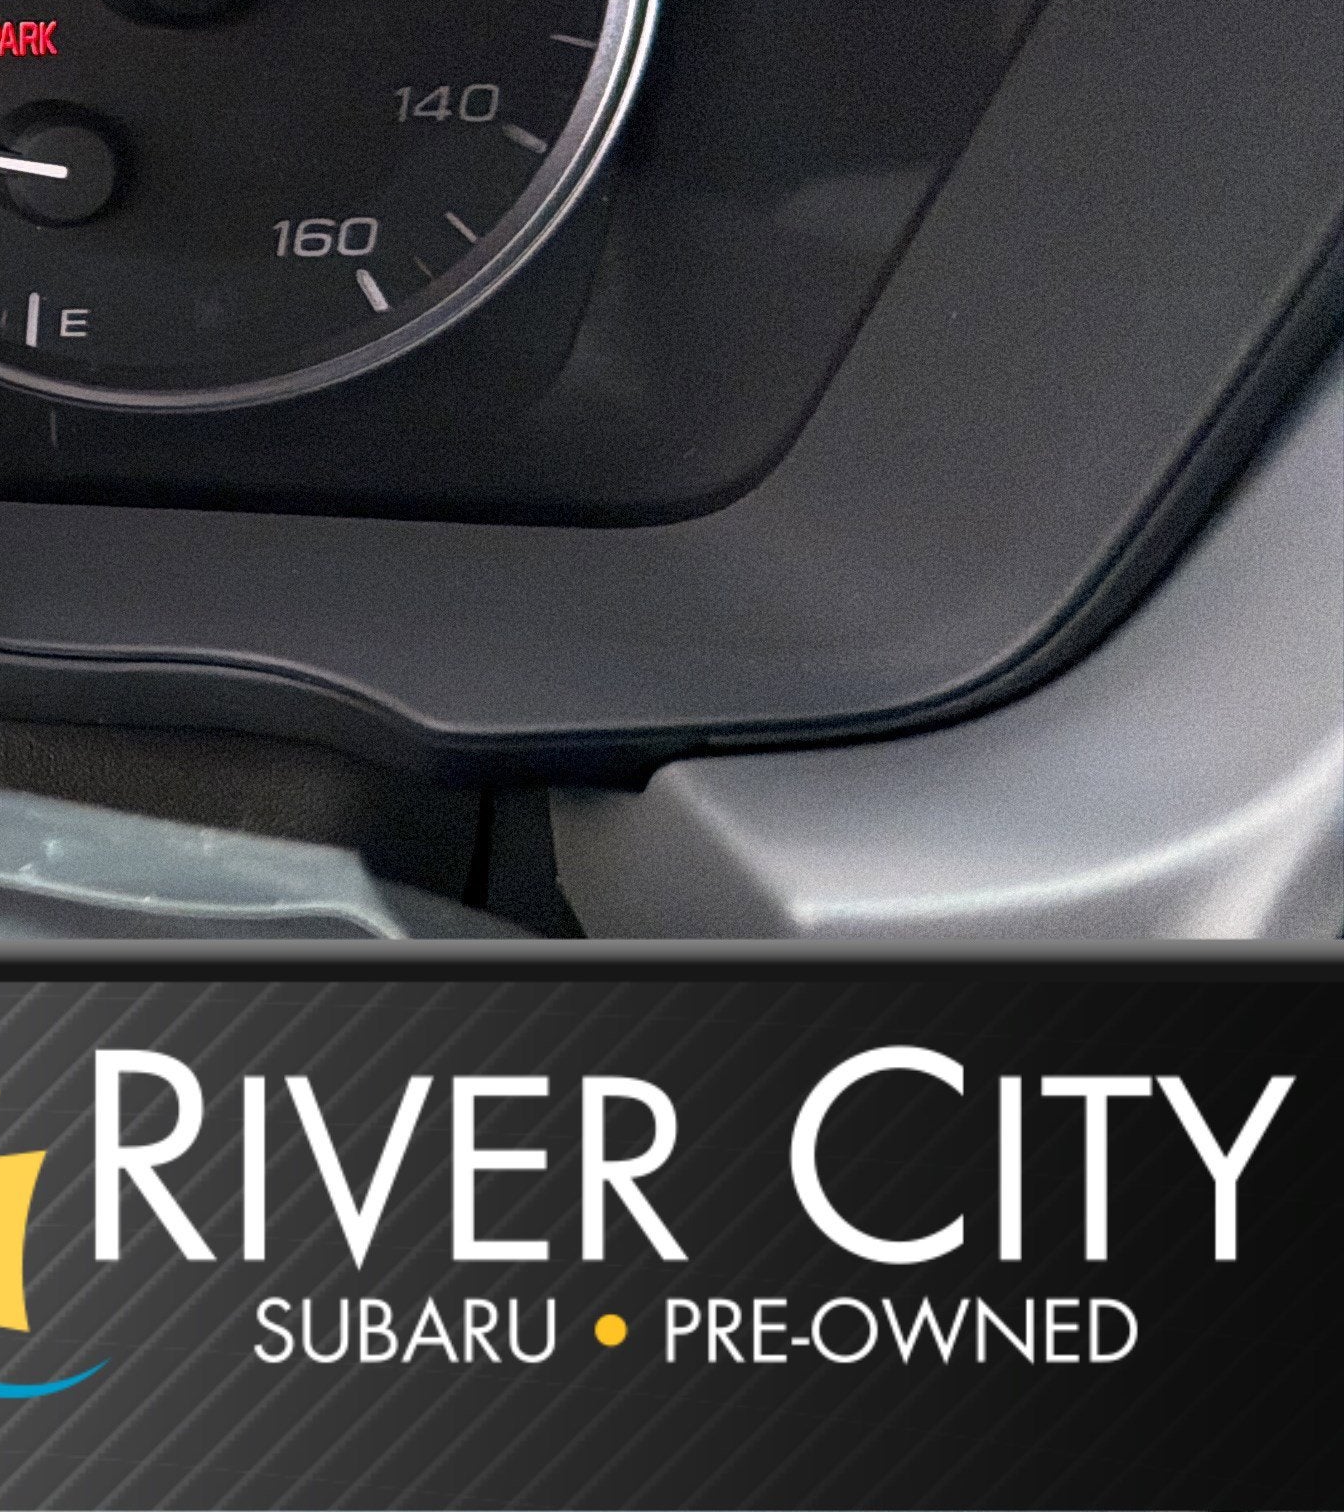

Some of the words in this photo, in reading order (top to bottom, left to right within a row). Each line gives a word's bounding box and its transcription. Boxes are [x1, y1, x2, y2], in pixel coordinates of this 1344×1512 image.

[394, 83, 500, 123] 140
[273, 217, 379, 258] 160
[60, 308, 89, 338] E
